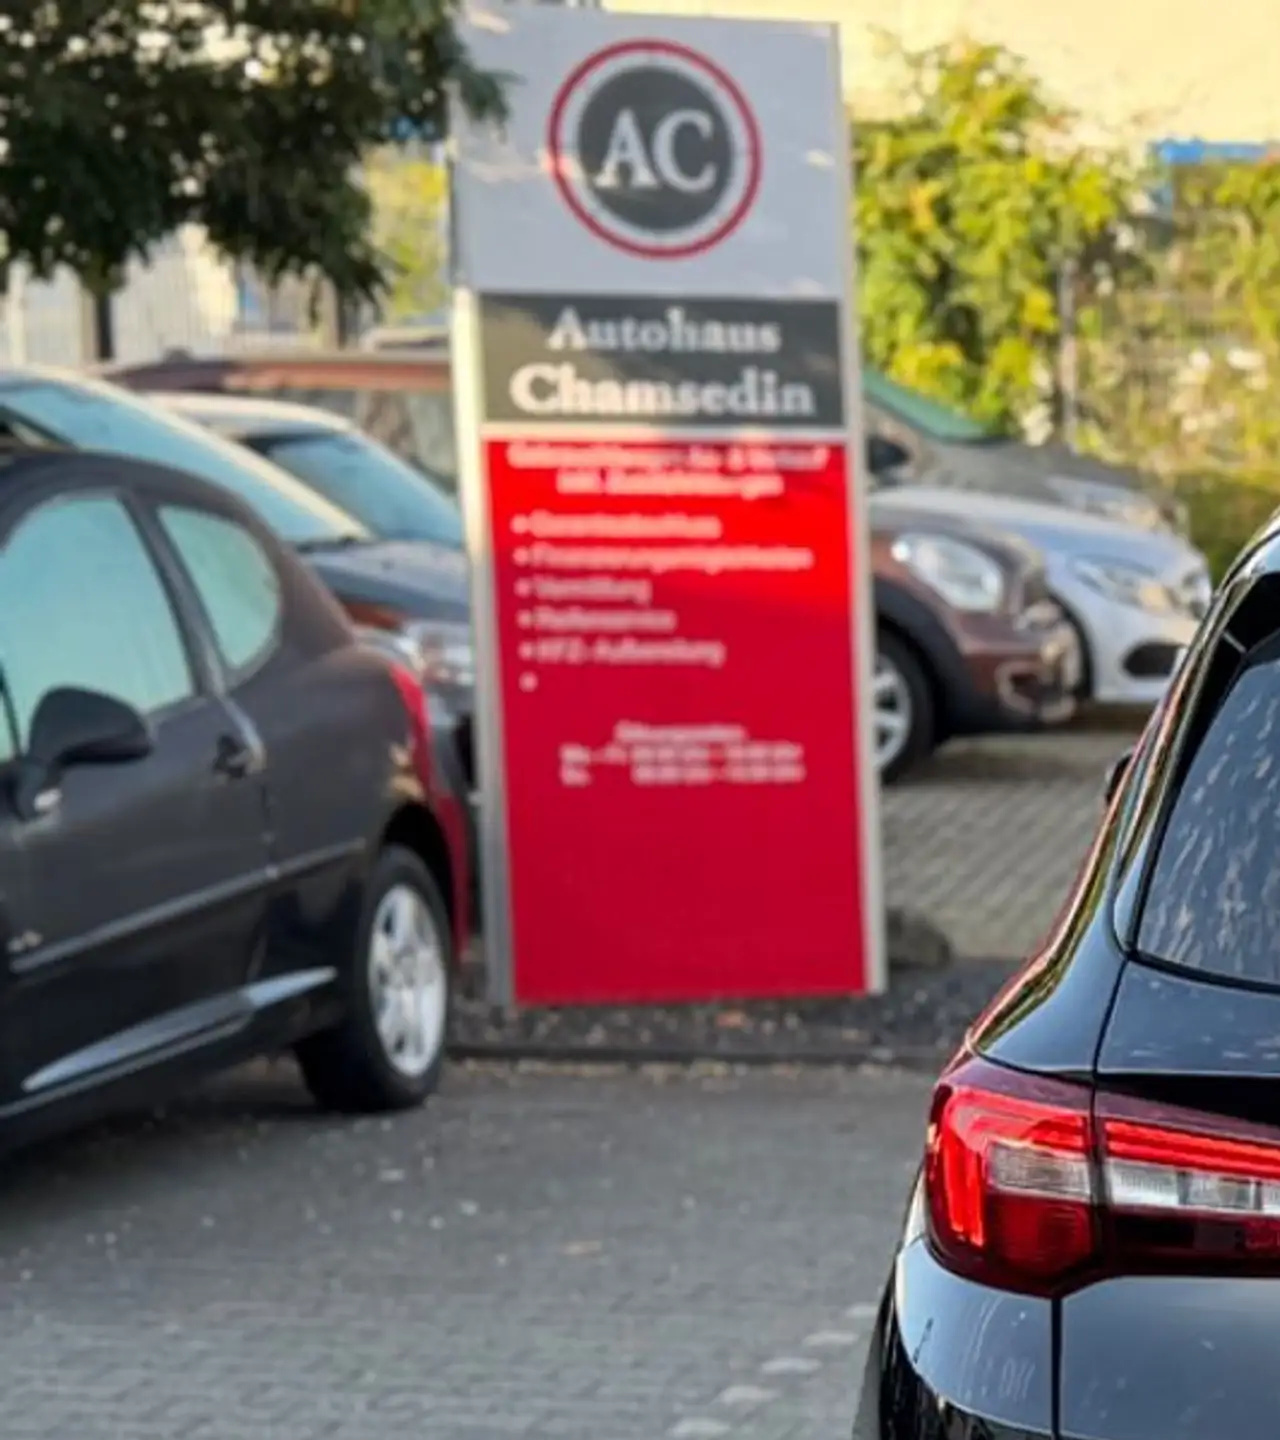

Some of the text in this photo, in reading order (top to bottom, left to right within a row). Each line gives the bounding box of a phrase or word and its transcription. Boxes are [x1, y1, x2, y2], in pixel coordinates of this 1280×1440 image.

[596, 107, 716, 193] AC
[547, 306, 782, 353] Autohaus
[509, 362, 815, 417] Chamsedin
